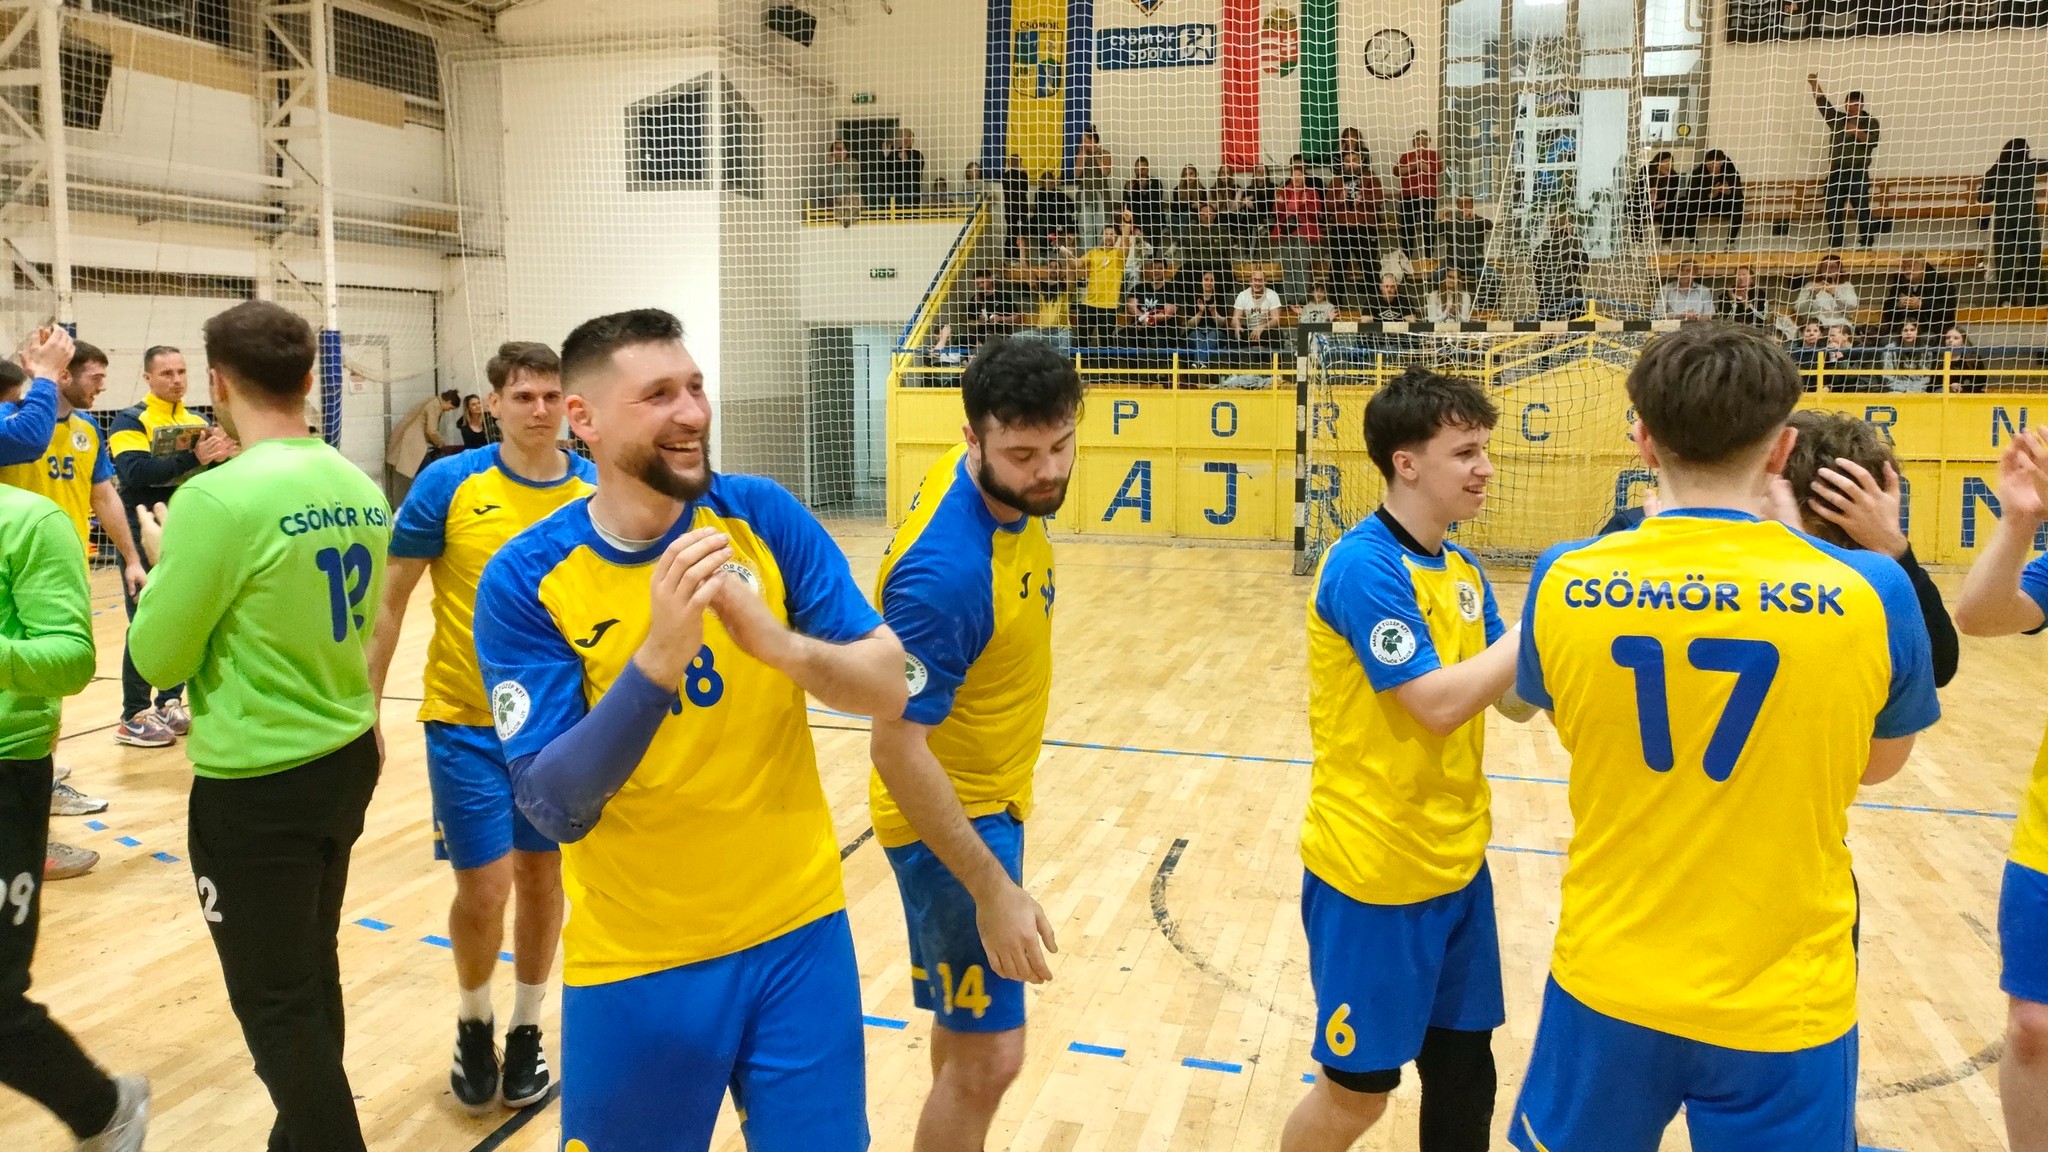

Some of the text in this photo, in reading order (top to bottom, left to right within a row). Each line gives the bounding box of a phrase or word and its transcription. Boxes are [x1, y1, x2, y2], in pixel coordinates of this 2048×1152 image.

[1128, 46, 1174, 61] sport
[47, 455, 76, 481] 35
[1564, 570, 1845, 617] CSÖMÖR KSK
[1610, 633, 1781, 783] 17
[937, 962, 992, 1019] 14
[1325, 1003, 1357, 1057] 6
